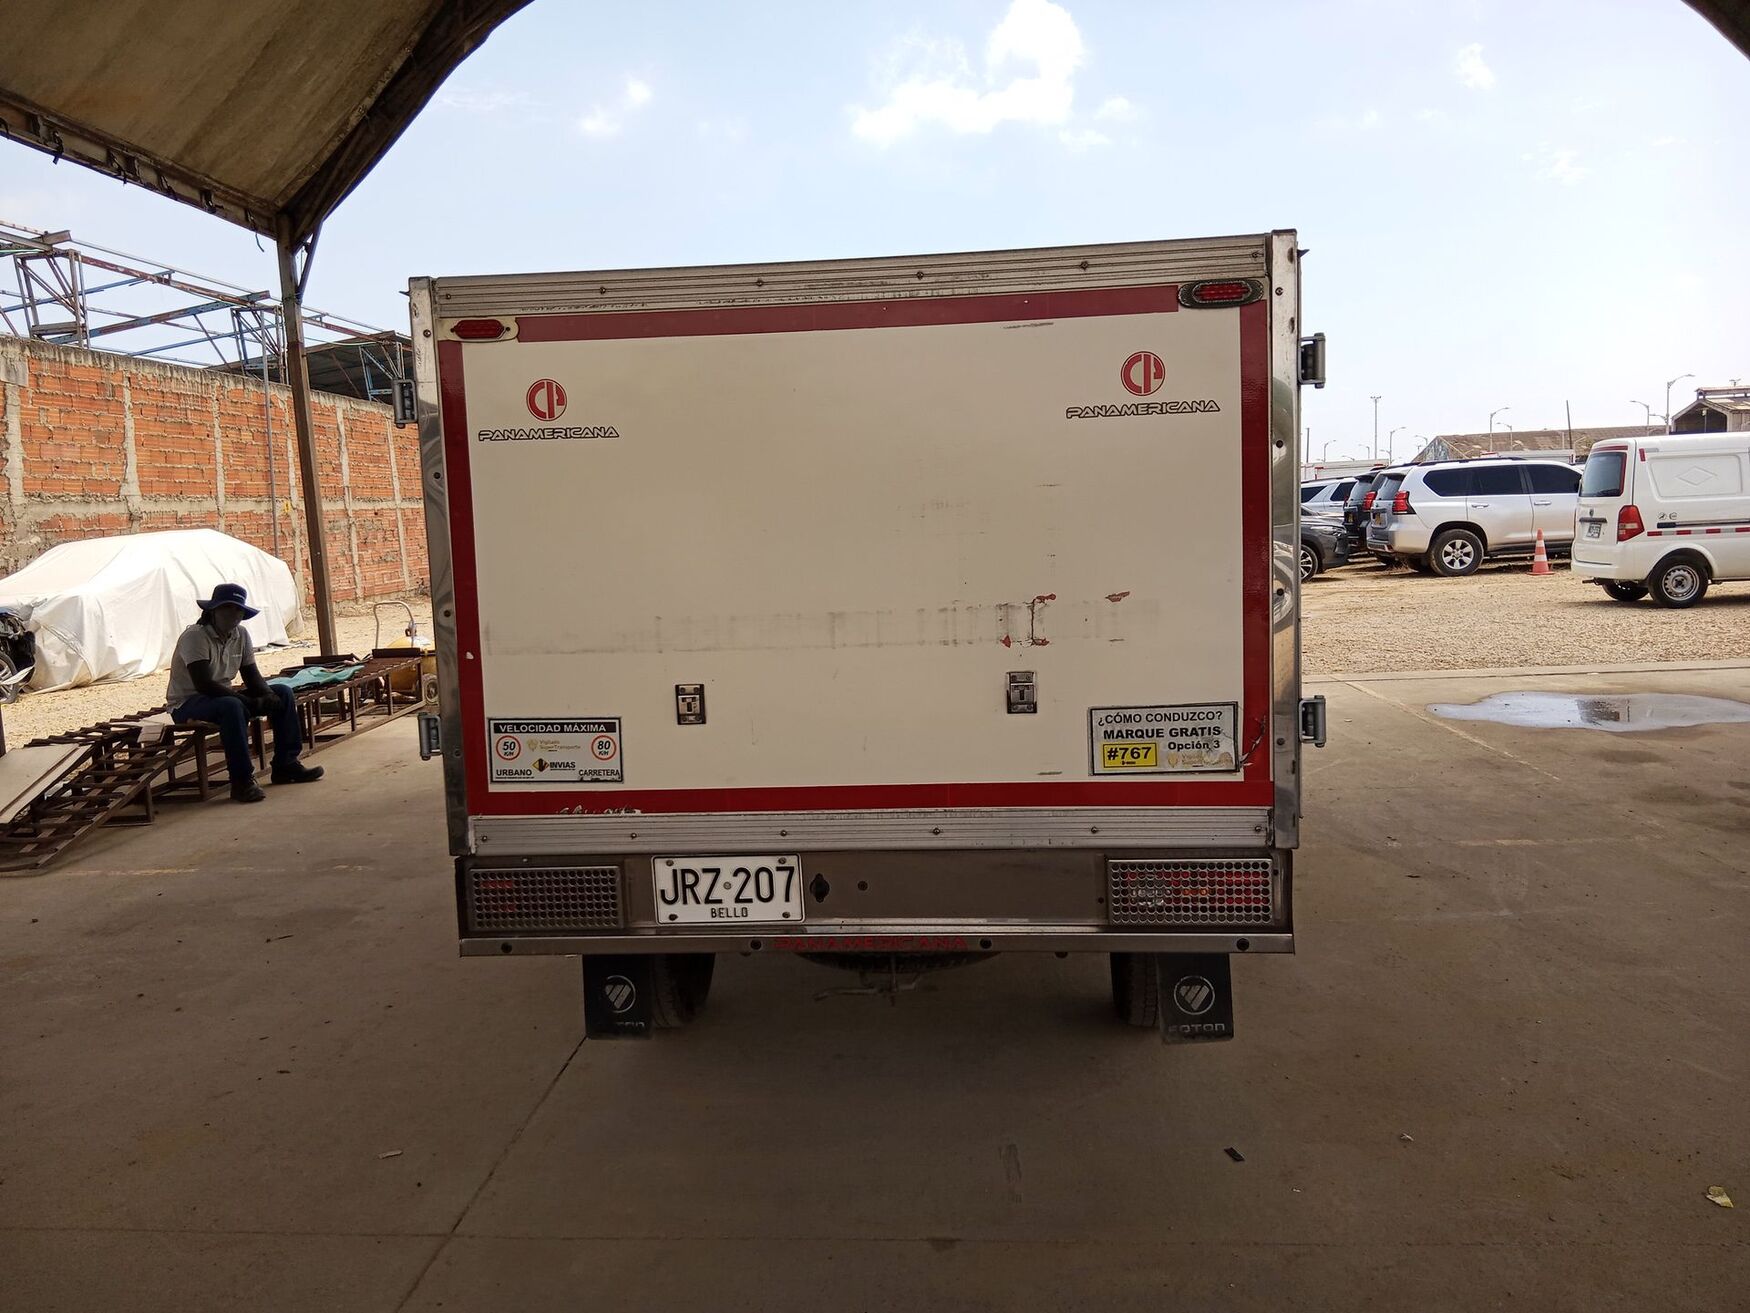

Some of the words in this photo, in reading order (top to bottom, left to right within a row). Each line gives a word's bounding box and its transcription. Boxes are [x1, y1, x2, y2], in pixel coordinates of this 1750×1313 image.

[1066, 400, 1220, 419] PANAMERICANA
[478, 426, 619, 442] PANAMERICANA
[1098, 712, 1142, 726] ¿CÓMO
[1145, 711, 1223, 723] CONDUZCO?
[564, 723, 607, 732] MÁXIMA
[1103, 728, 1164, 739] MARQUE
[1169, 726, 1221, 738] GRATIS
[502, 741, 516, 751] 50
[597, 740, 611, 750] 80
[1168, 741, 1209, 751] Opción
[1213, 740, 1220, 749] 3
[1107, 747, 1152, 760] #767
[550, 761, 576, 769] INVIAS
[660, 867, 723, 906] JRZ
[732, 865, 795, 905] 207
[710, 906, 749, 919] BELLO
